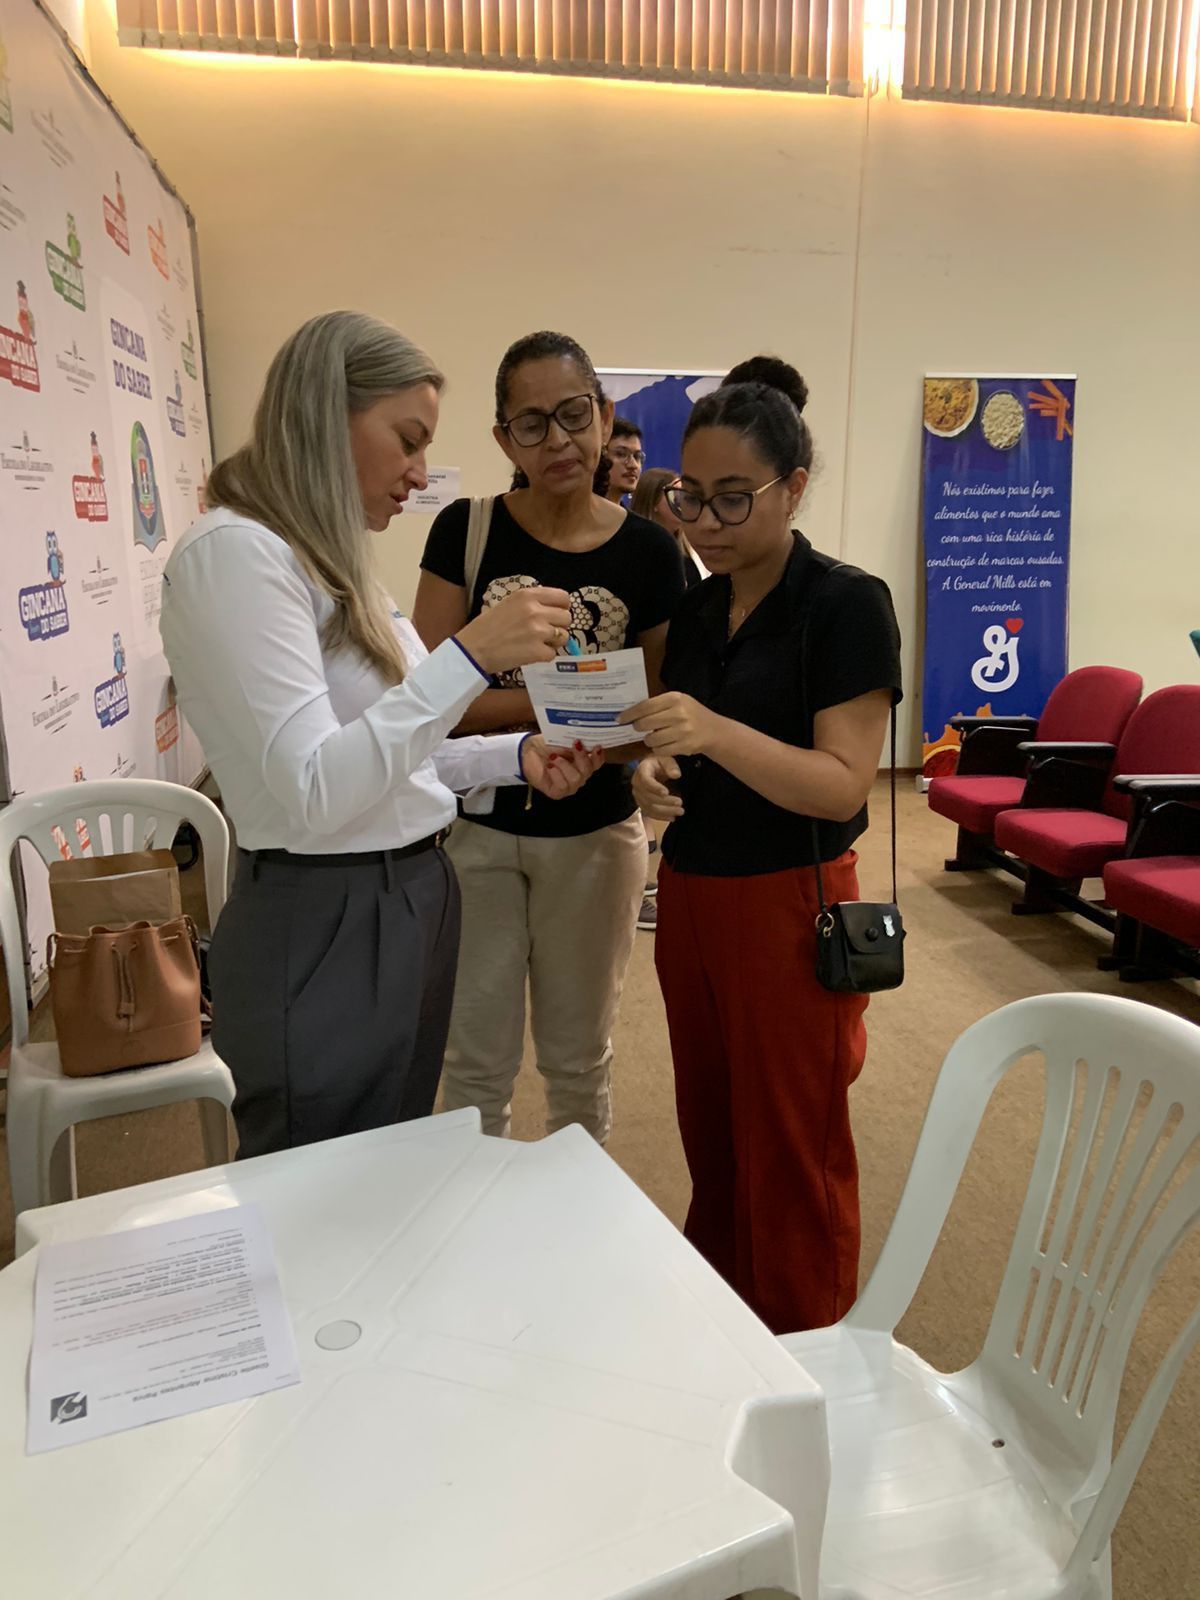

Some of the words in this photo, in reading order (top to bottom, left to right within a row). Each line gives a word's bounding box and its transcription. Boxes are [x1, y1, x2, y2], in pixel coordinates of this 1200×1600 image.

[110, 317, 147, 362] GINCANA
[113, 359, 126, 390] DO
[126, 365, 153, 400] SABER
[74, 481, 106, 502] GINCANA
[943, 481, 961, 496] Nós
[963, 483, 1006, 496] existimos
[1007, 485, 1029, 499] para
[1031, 480, 1055, 499] fazer
[88, 504, 94, 516] DO
[94, 504, 107, 516] SABER
[934, 505, 979, 520] alimentos
[982, 510, 998, 522] que
[1008, 504, 1040, 518] mundo
[1041, 510, 1061, 518] ama
[941, 535, 959, 544] com
[962, 534, 982, 543] uma
[986, 531, 1003, 542] rica
[1006, 528, 1041, 542] história
[1043, 528, 1054, 542] de
[927, 555, 976, 569] construção
[977, 552, 989, 566] de
[991, 556, 1025, 566] marcas
[1027, 551, 1064, 565] ousadas.
[942, 576, 951, 590] A
[953, 575, 992, 591] General
[992, 574, 1016, 589] Mills
[1018, 576, 1037, 588] está
[1039, 580, 1051, 588] em
[22, 587, 66, 622] GINCANA
[971, 600, 1022, 612] movimento.
[40, 618, 49, 633] DO
[49, 612, 67, 629] SABER
[96, 677, 127, 714] GINCANA
[109, 706, 116, 720] DO
[115, 698, 128, 716] SABER
